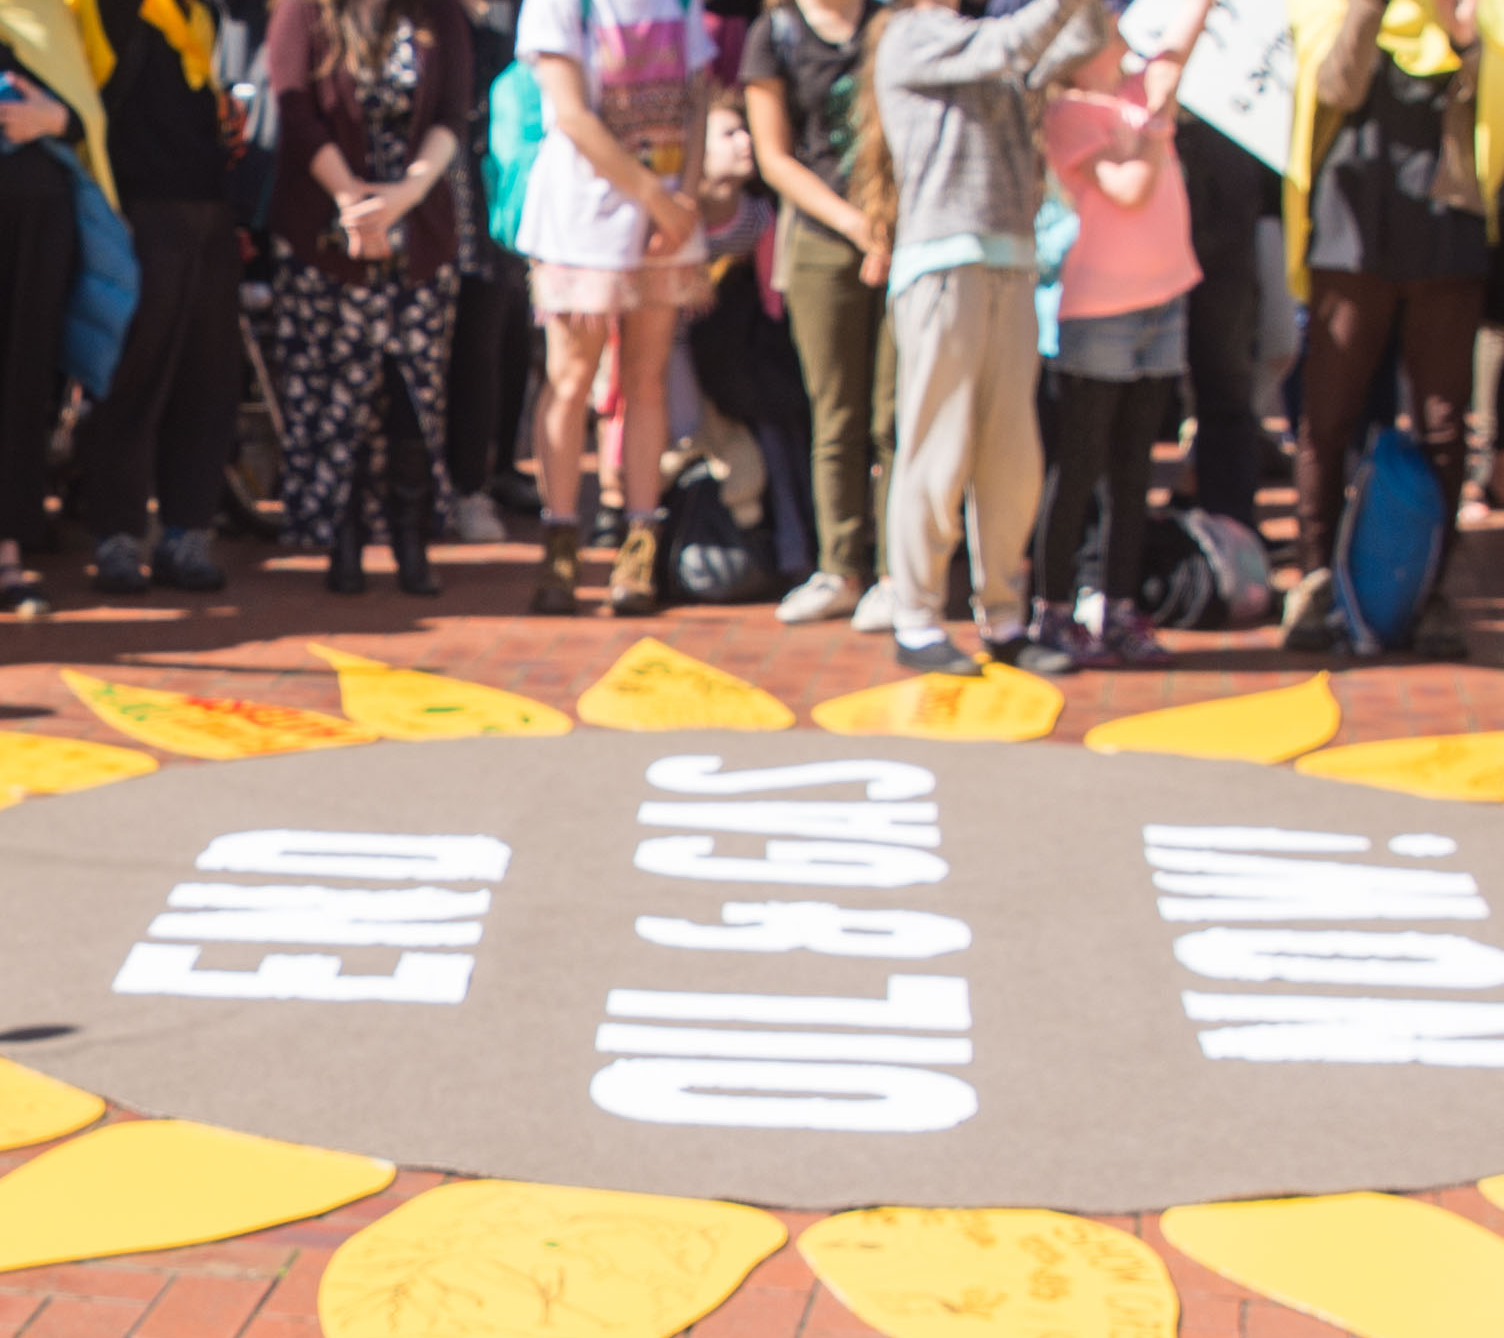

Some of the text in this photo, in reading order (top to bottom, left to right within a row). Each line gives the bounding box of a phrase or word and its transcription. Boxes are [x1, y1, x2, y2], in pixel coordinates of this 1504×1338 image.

[633, 754, 950, 889] GAS
[111, 829, 512, 1005] END
[633, 900, 973, 959] &
[589, 972, 979, 1133] OIL
